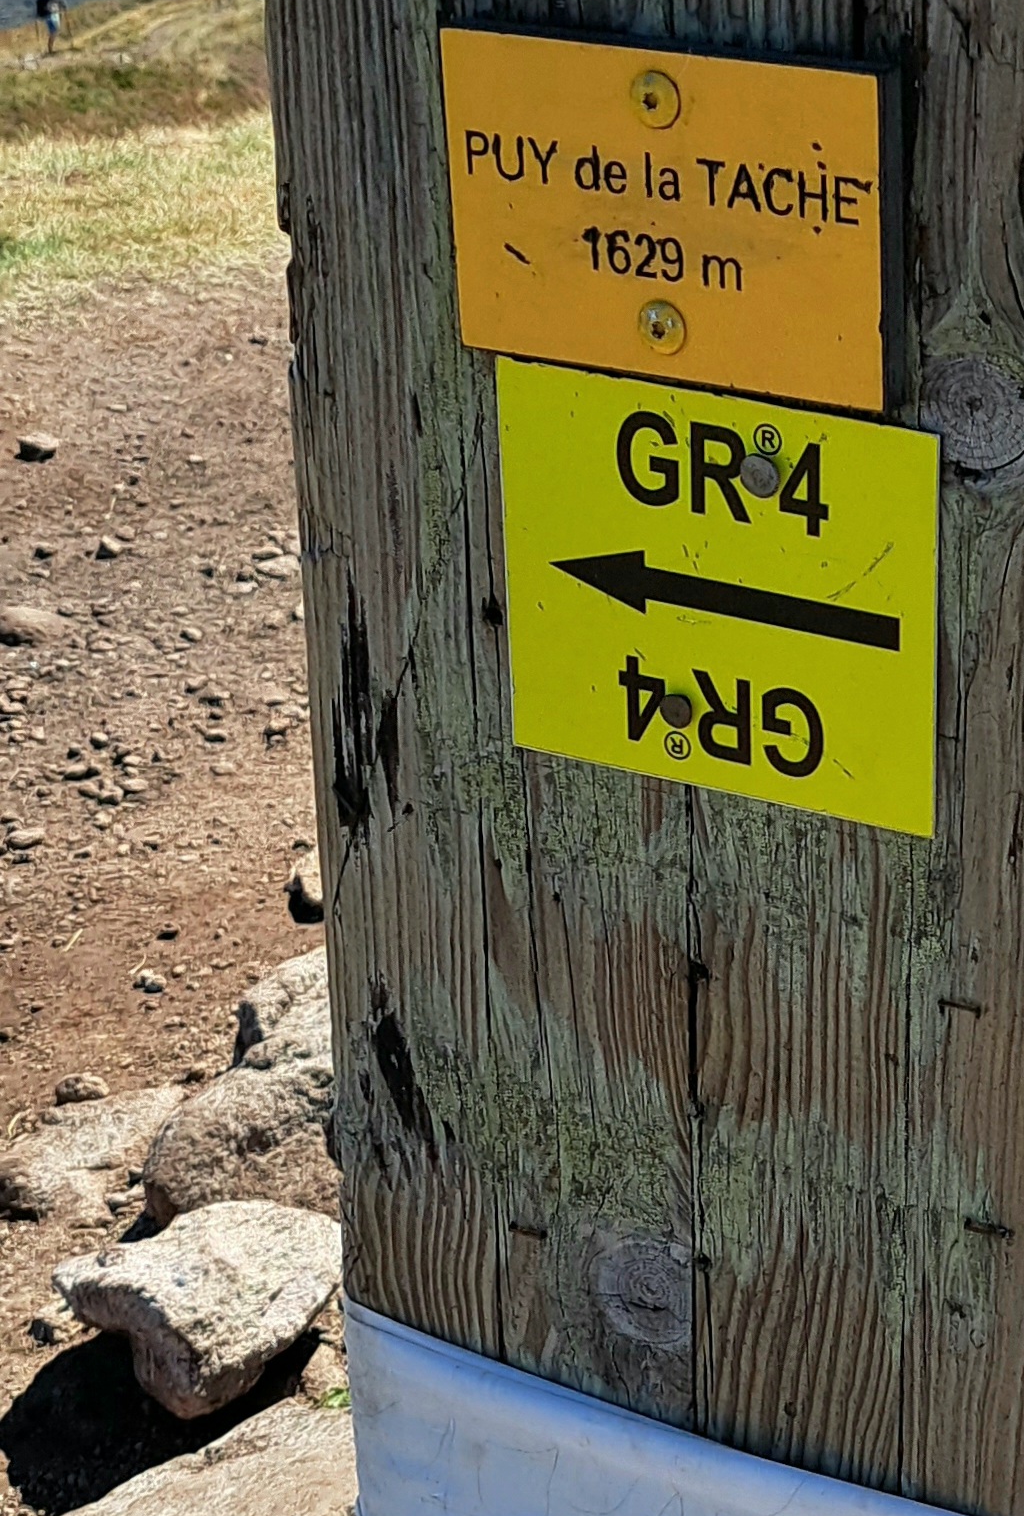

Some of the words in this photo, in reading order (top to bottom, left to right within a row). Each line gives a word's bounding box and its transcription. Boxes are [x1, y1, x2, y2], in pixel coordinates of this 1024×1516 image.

[465, 130, 558, 184] PUY
[574, 145, 627, 196] de
[644, 152, 682, 202] la
[697, 158, 867, 226] TACHE
[582, 226, 684, 283] 1629
[702, 262, 743, 292] m
